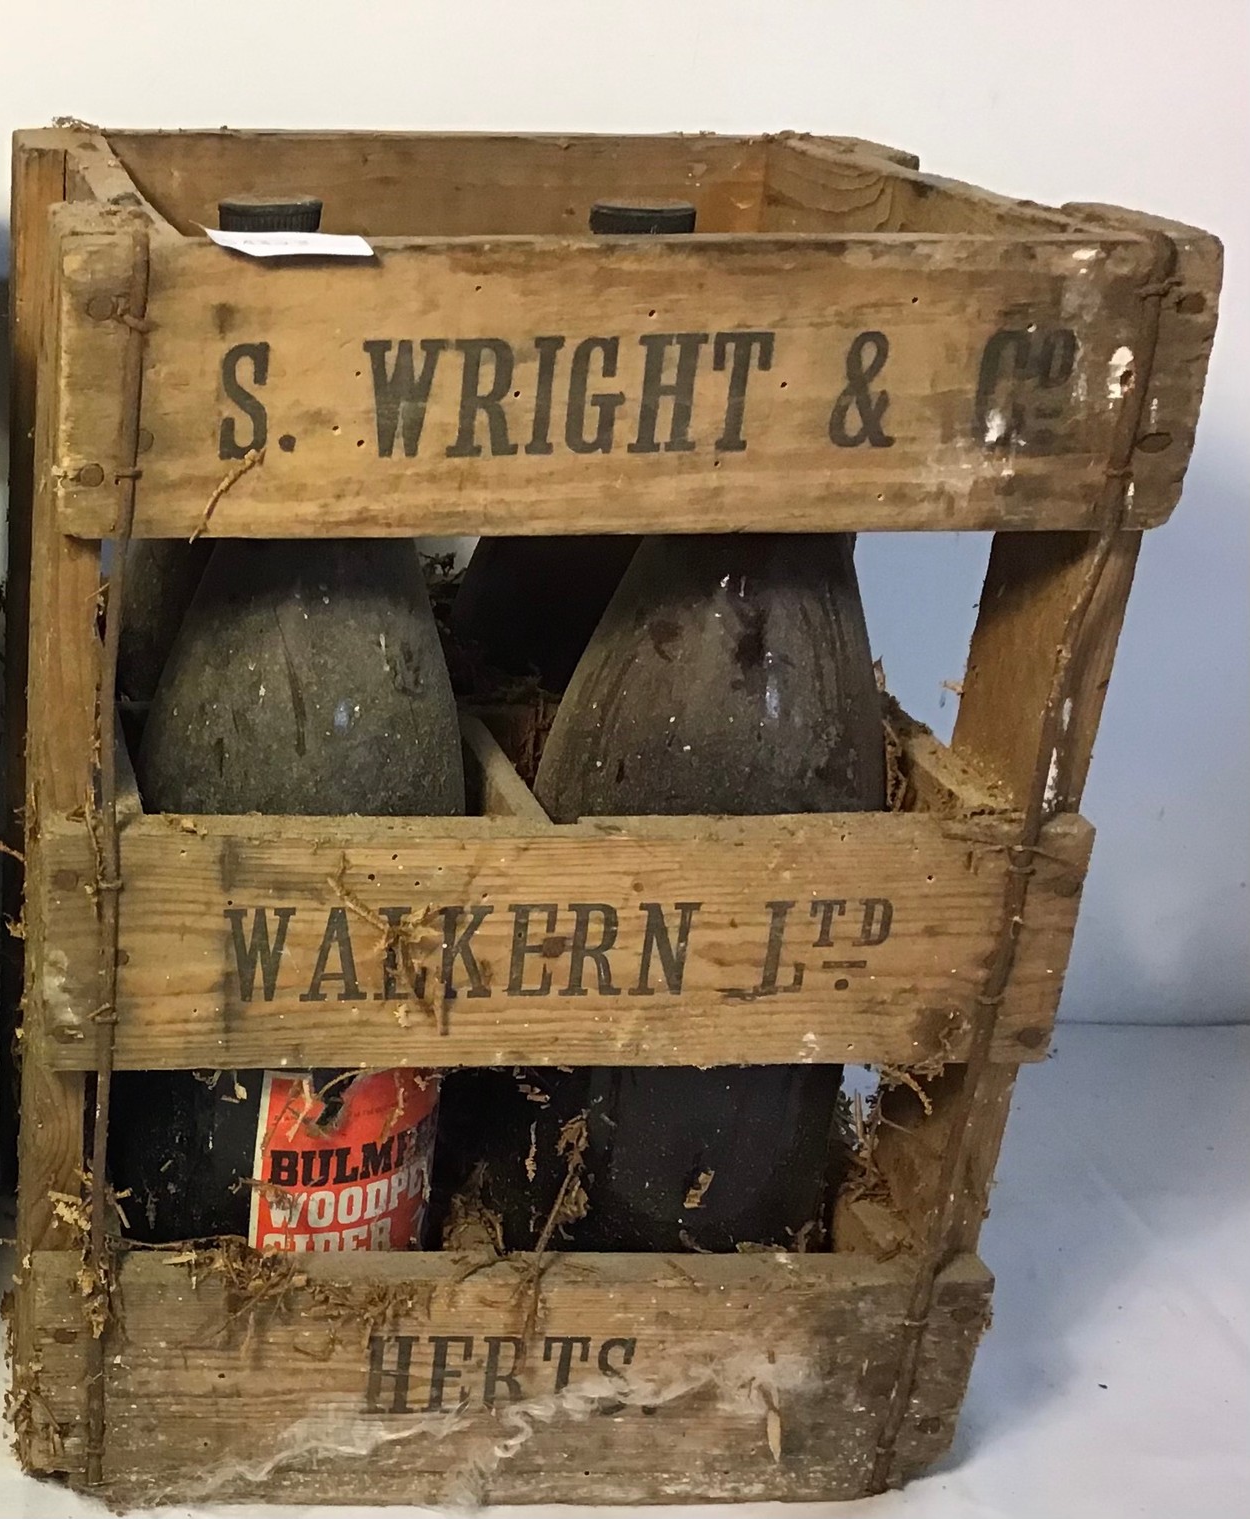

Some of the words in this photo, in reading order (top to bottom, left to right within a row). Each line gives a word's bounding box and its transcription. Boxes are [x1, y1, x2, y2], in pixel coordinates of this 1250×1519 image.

[219, 342, 296, 460] S.
[364, 330, 774, 458] WRIGHT
[831, 330, 895, 447] &
[224, 902, 703, 1002] WALKERN
